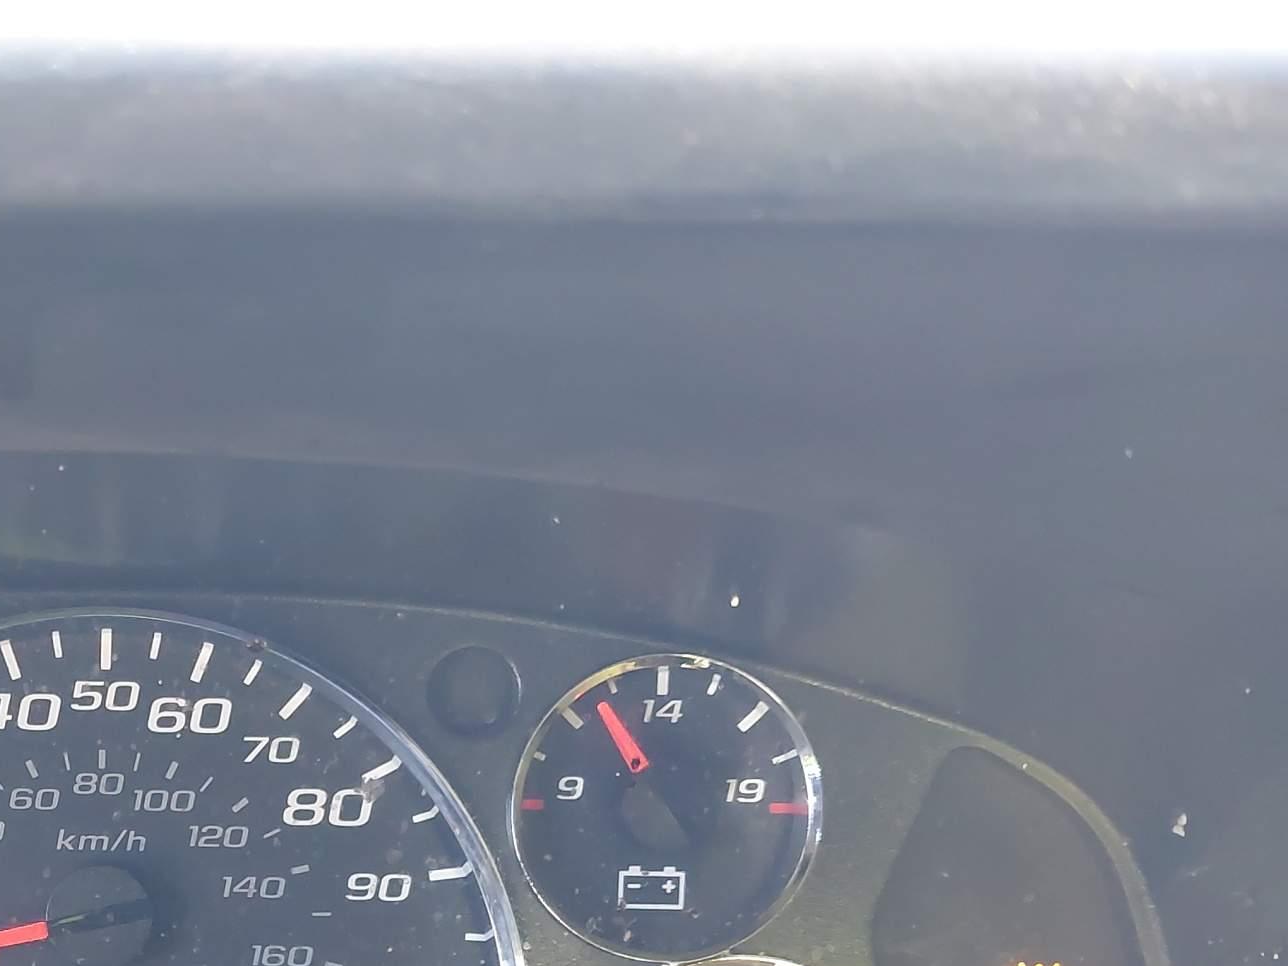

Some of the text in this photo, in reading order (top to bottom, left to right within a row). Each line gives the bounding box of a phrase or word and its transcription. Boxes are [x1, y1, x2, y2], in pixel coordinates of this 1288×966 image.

[70, 681, 141, 712] 50
[146, 696, 233, 734] 60
[642, 699, 684, 723] 14
[242, 736, 301, 763] 70
[73, 772, 125, 796] 80
[556, 775, 585, 801] 9
[724, 778, 766, 804] 19
[9, 788, 60, 811] 60
[133, 789, 197, 812] 100
[282, 787, 376, 827] 80
[56, 829, 146, 852] km/h
[188, 825, 249, 848] 120
[222, 876, 287, 899] 140
[344, 873, 412, 902] 90
